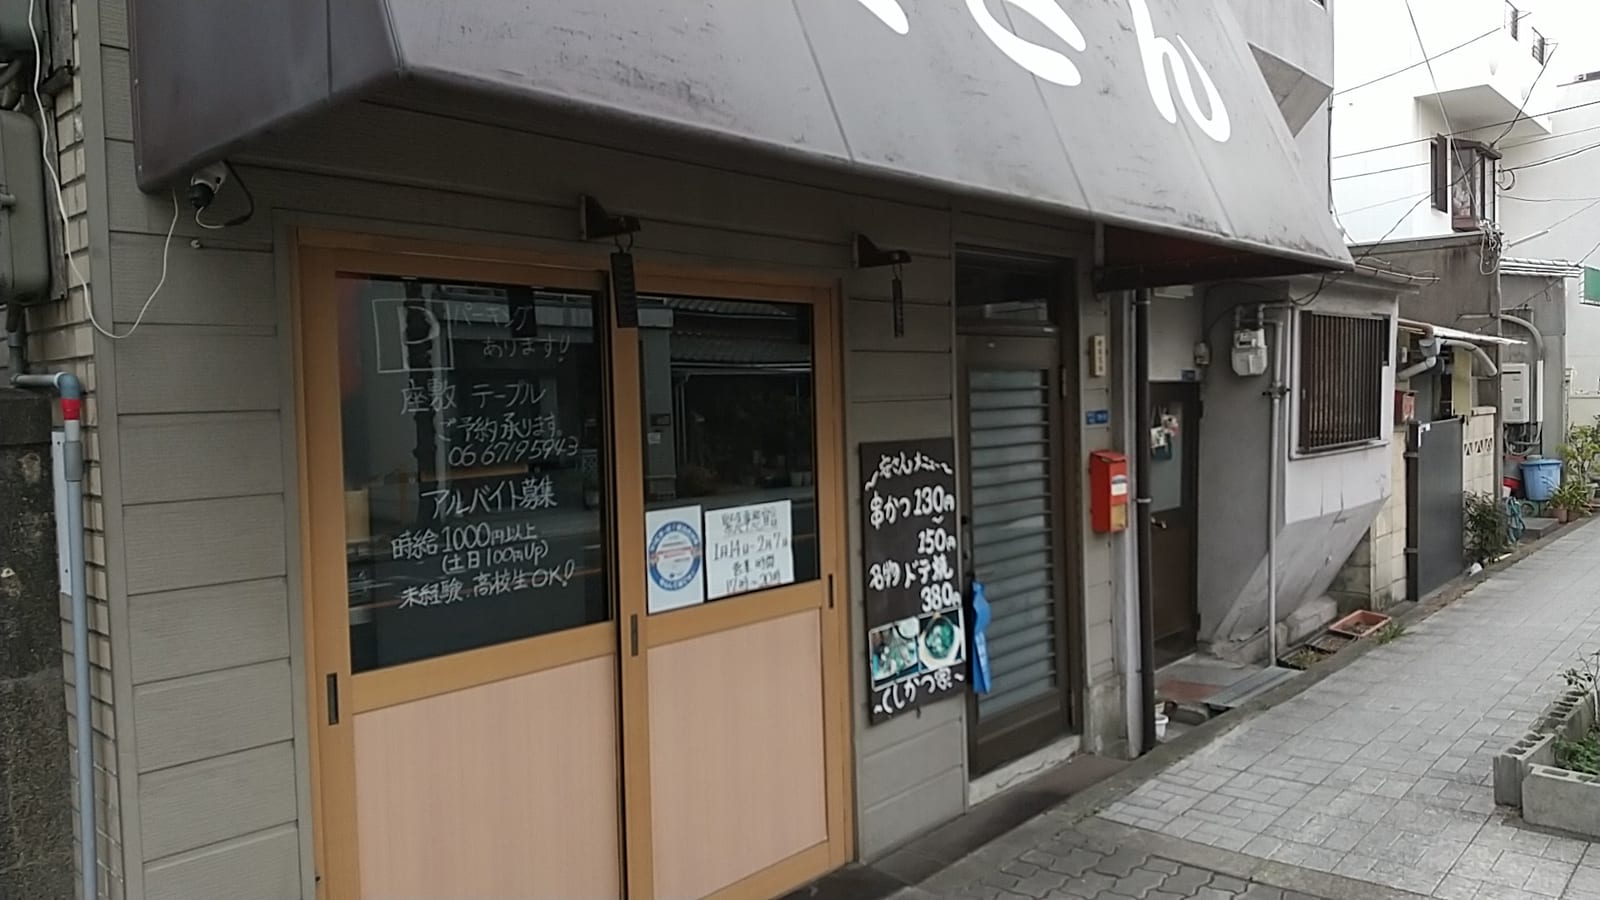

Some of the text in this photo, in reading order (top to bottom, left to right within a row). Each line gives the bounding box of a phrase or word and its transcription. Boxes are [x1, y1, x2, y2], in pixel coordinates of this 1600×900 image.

[400, 377, 547, 415] 座敷 テーブル
[421, 474, 558, 519] アルバイト募集
[870, 490, 911, 531] 串かつ
